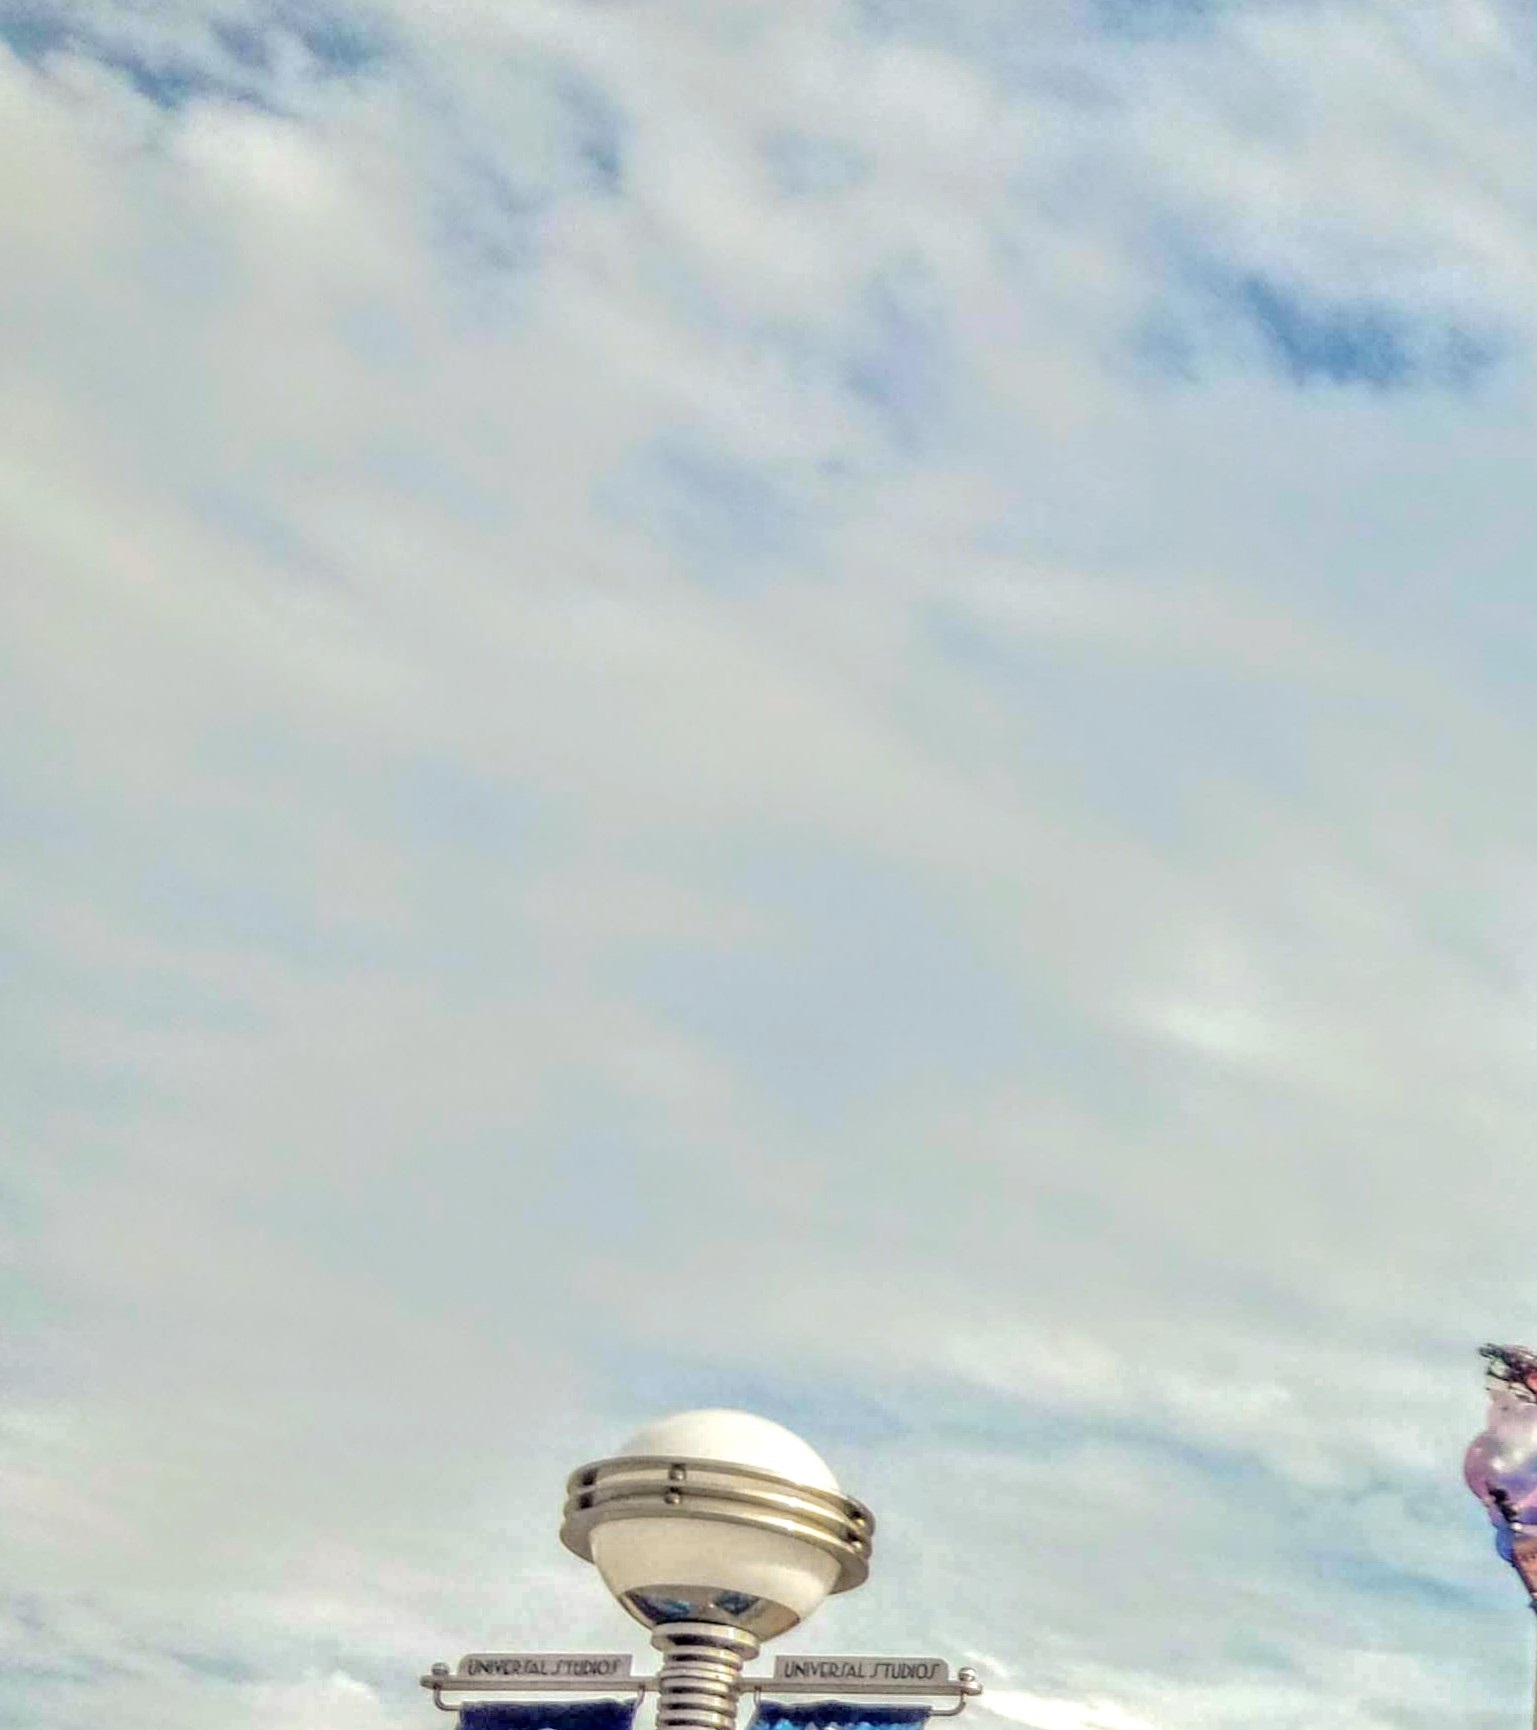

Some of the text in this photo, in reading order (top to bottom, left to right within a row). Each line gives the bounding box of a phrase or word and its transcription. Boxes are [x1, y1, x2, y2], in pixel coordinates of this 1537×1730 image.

[467, 1659, 621, 1675] UNIVERSAL STUDIOS
[784, 1661, 940, 1679] UNIVERSAL STUDIOS
